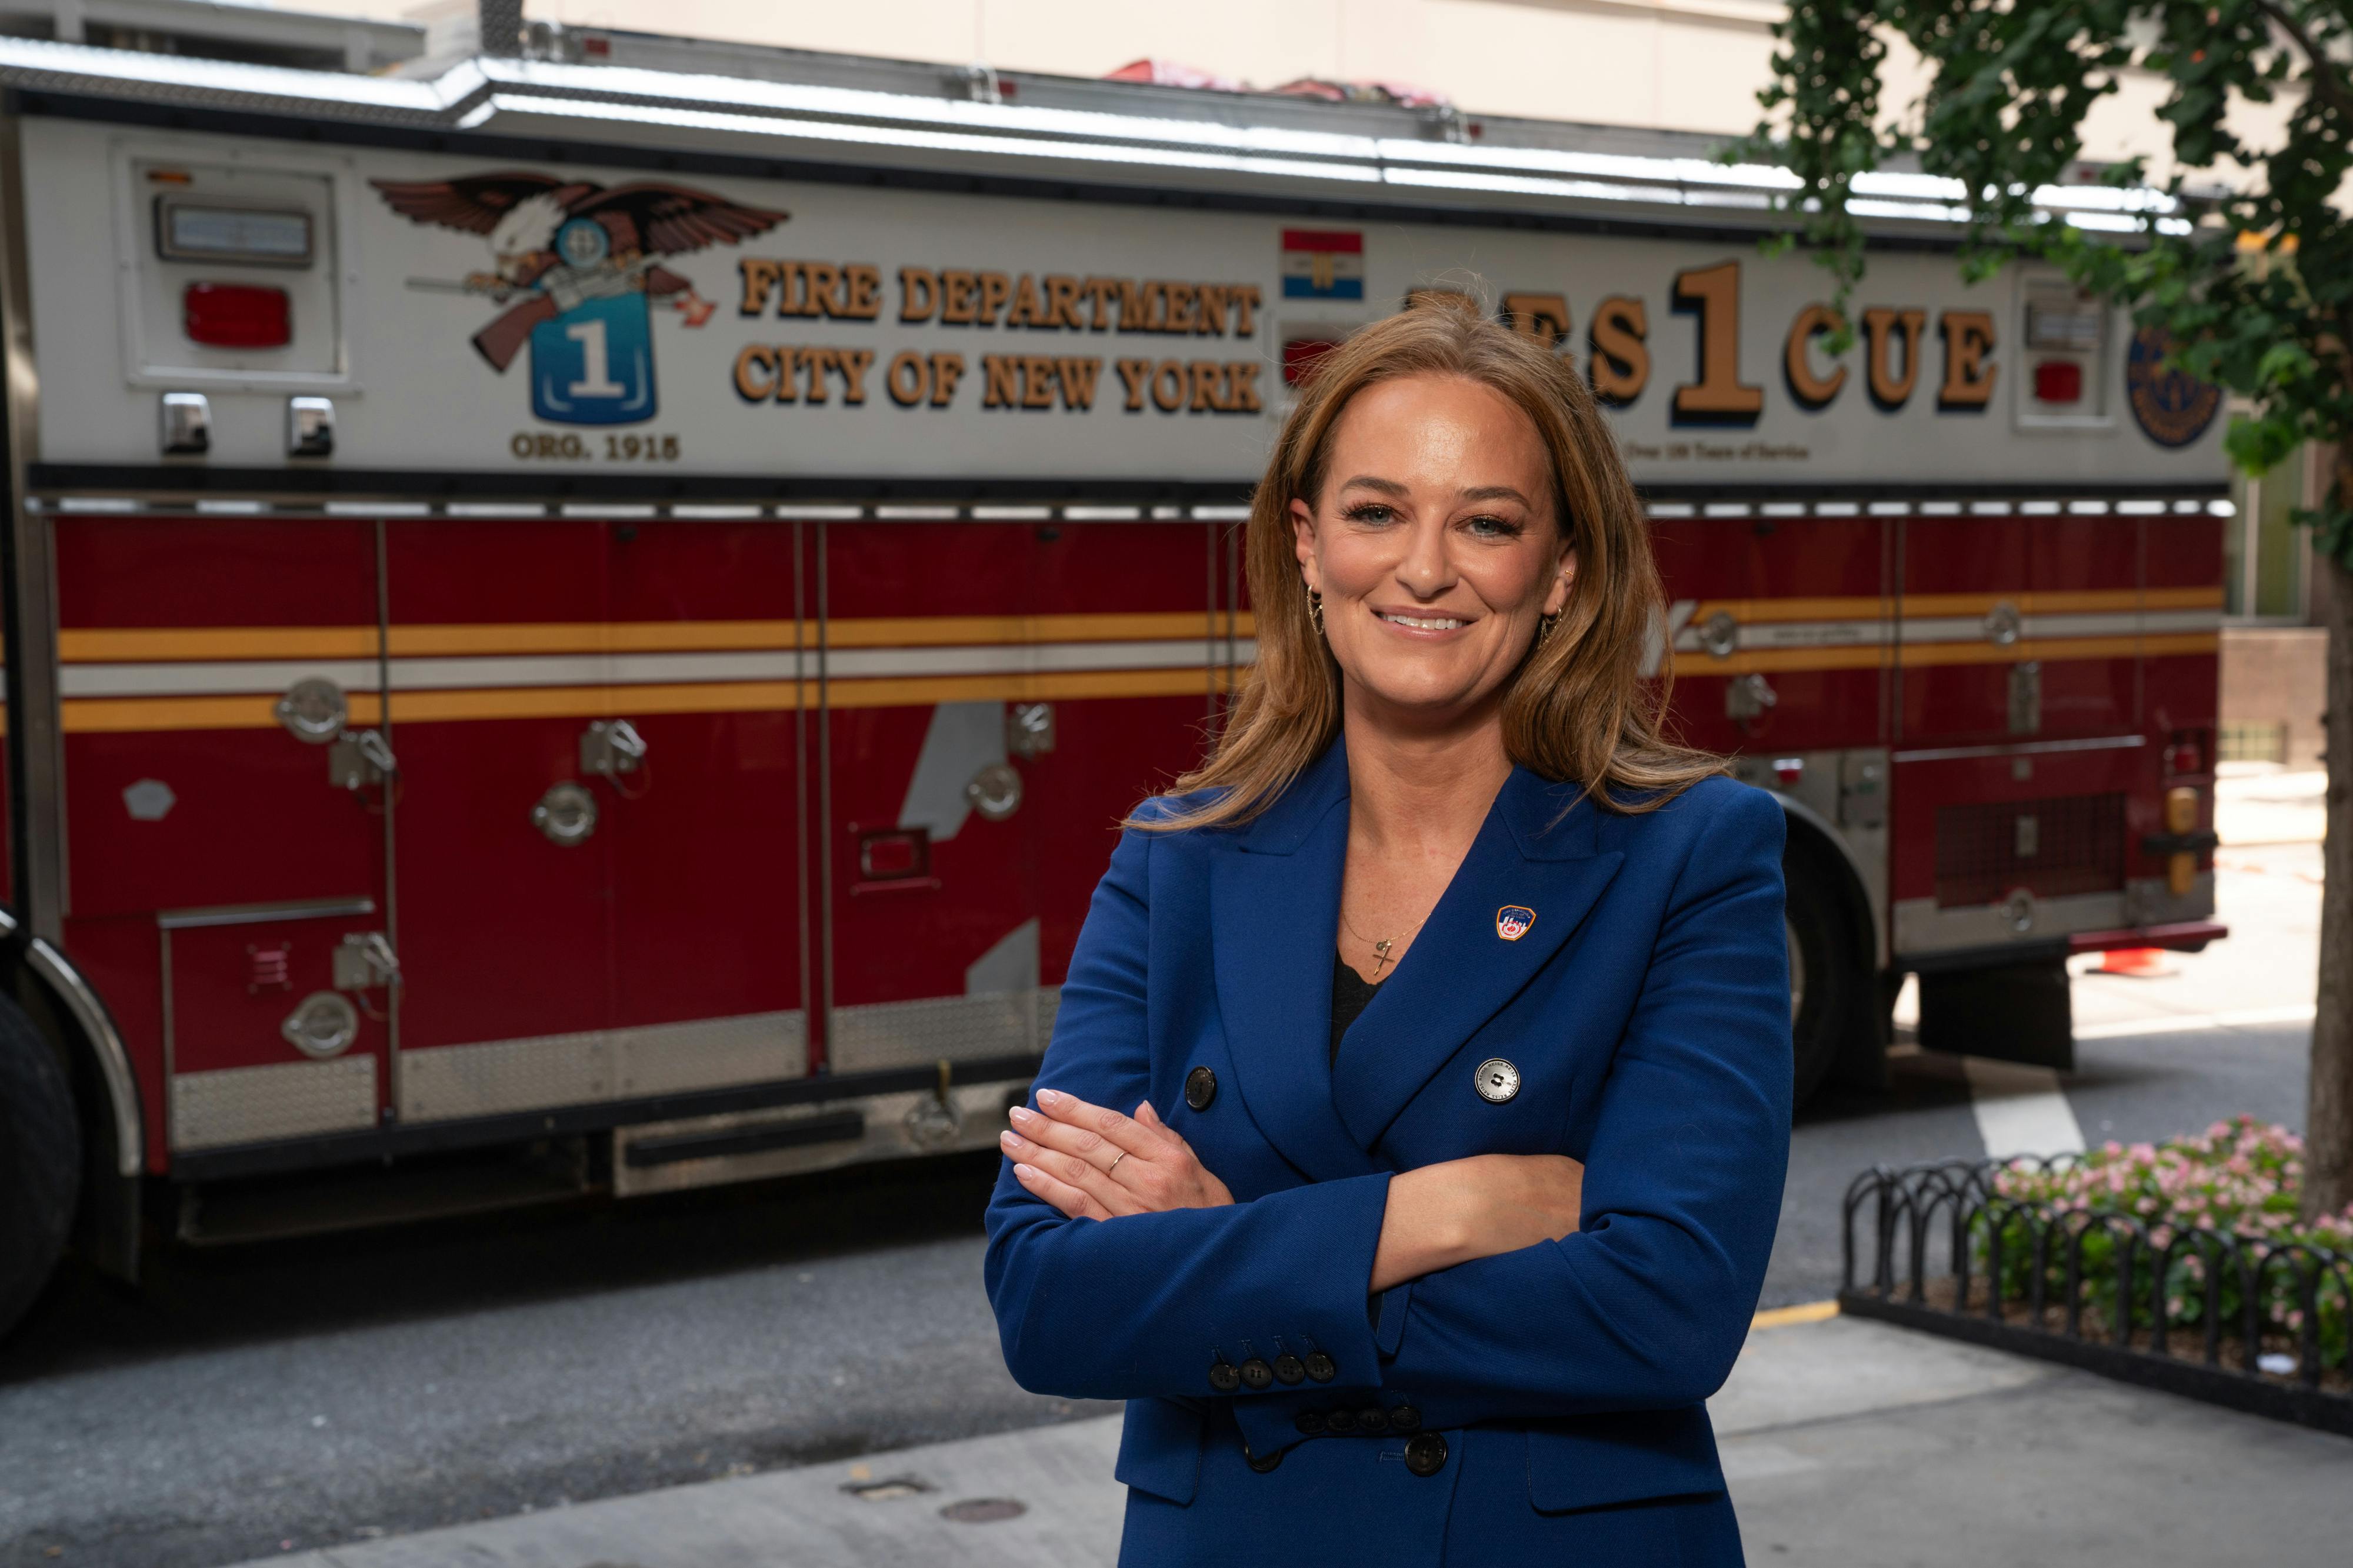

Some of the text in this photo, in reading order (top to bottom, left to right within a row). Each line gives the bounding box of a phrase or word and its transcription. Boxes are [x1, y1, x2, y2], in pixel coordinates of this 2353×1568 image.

[739, 259, 1261, 336] FIRE DEPARTMENT
[566, 319, 625, 397] 1
[734, 345, 1262, 416] CITY OF NEW YORK
[509, 433, 681, 461] ORG. 1915
[1505, 1065, 1516, 1077] REISS
